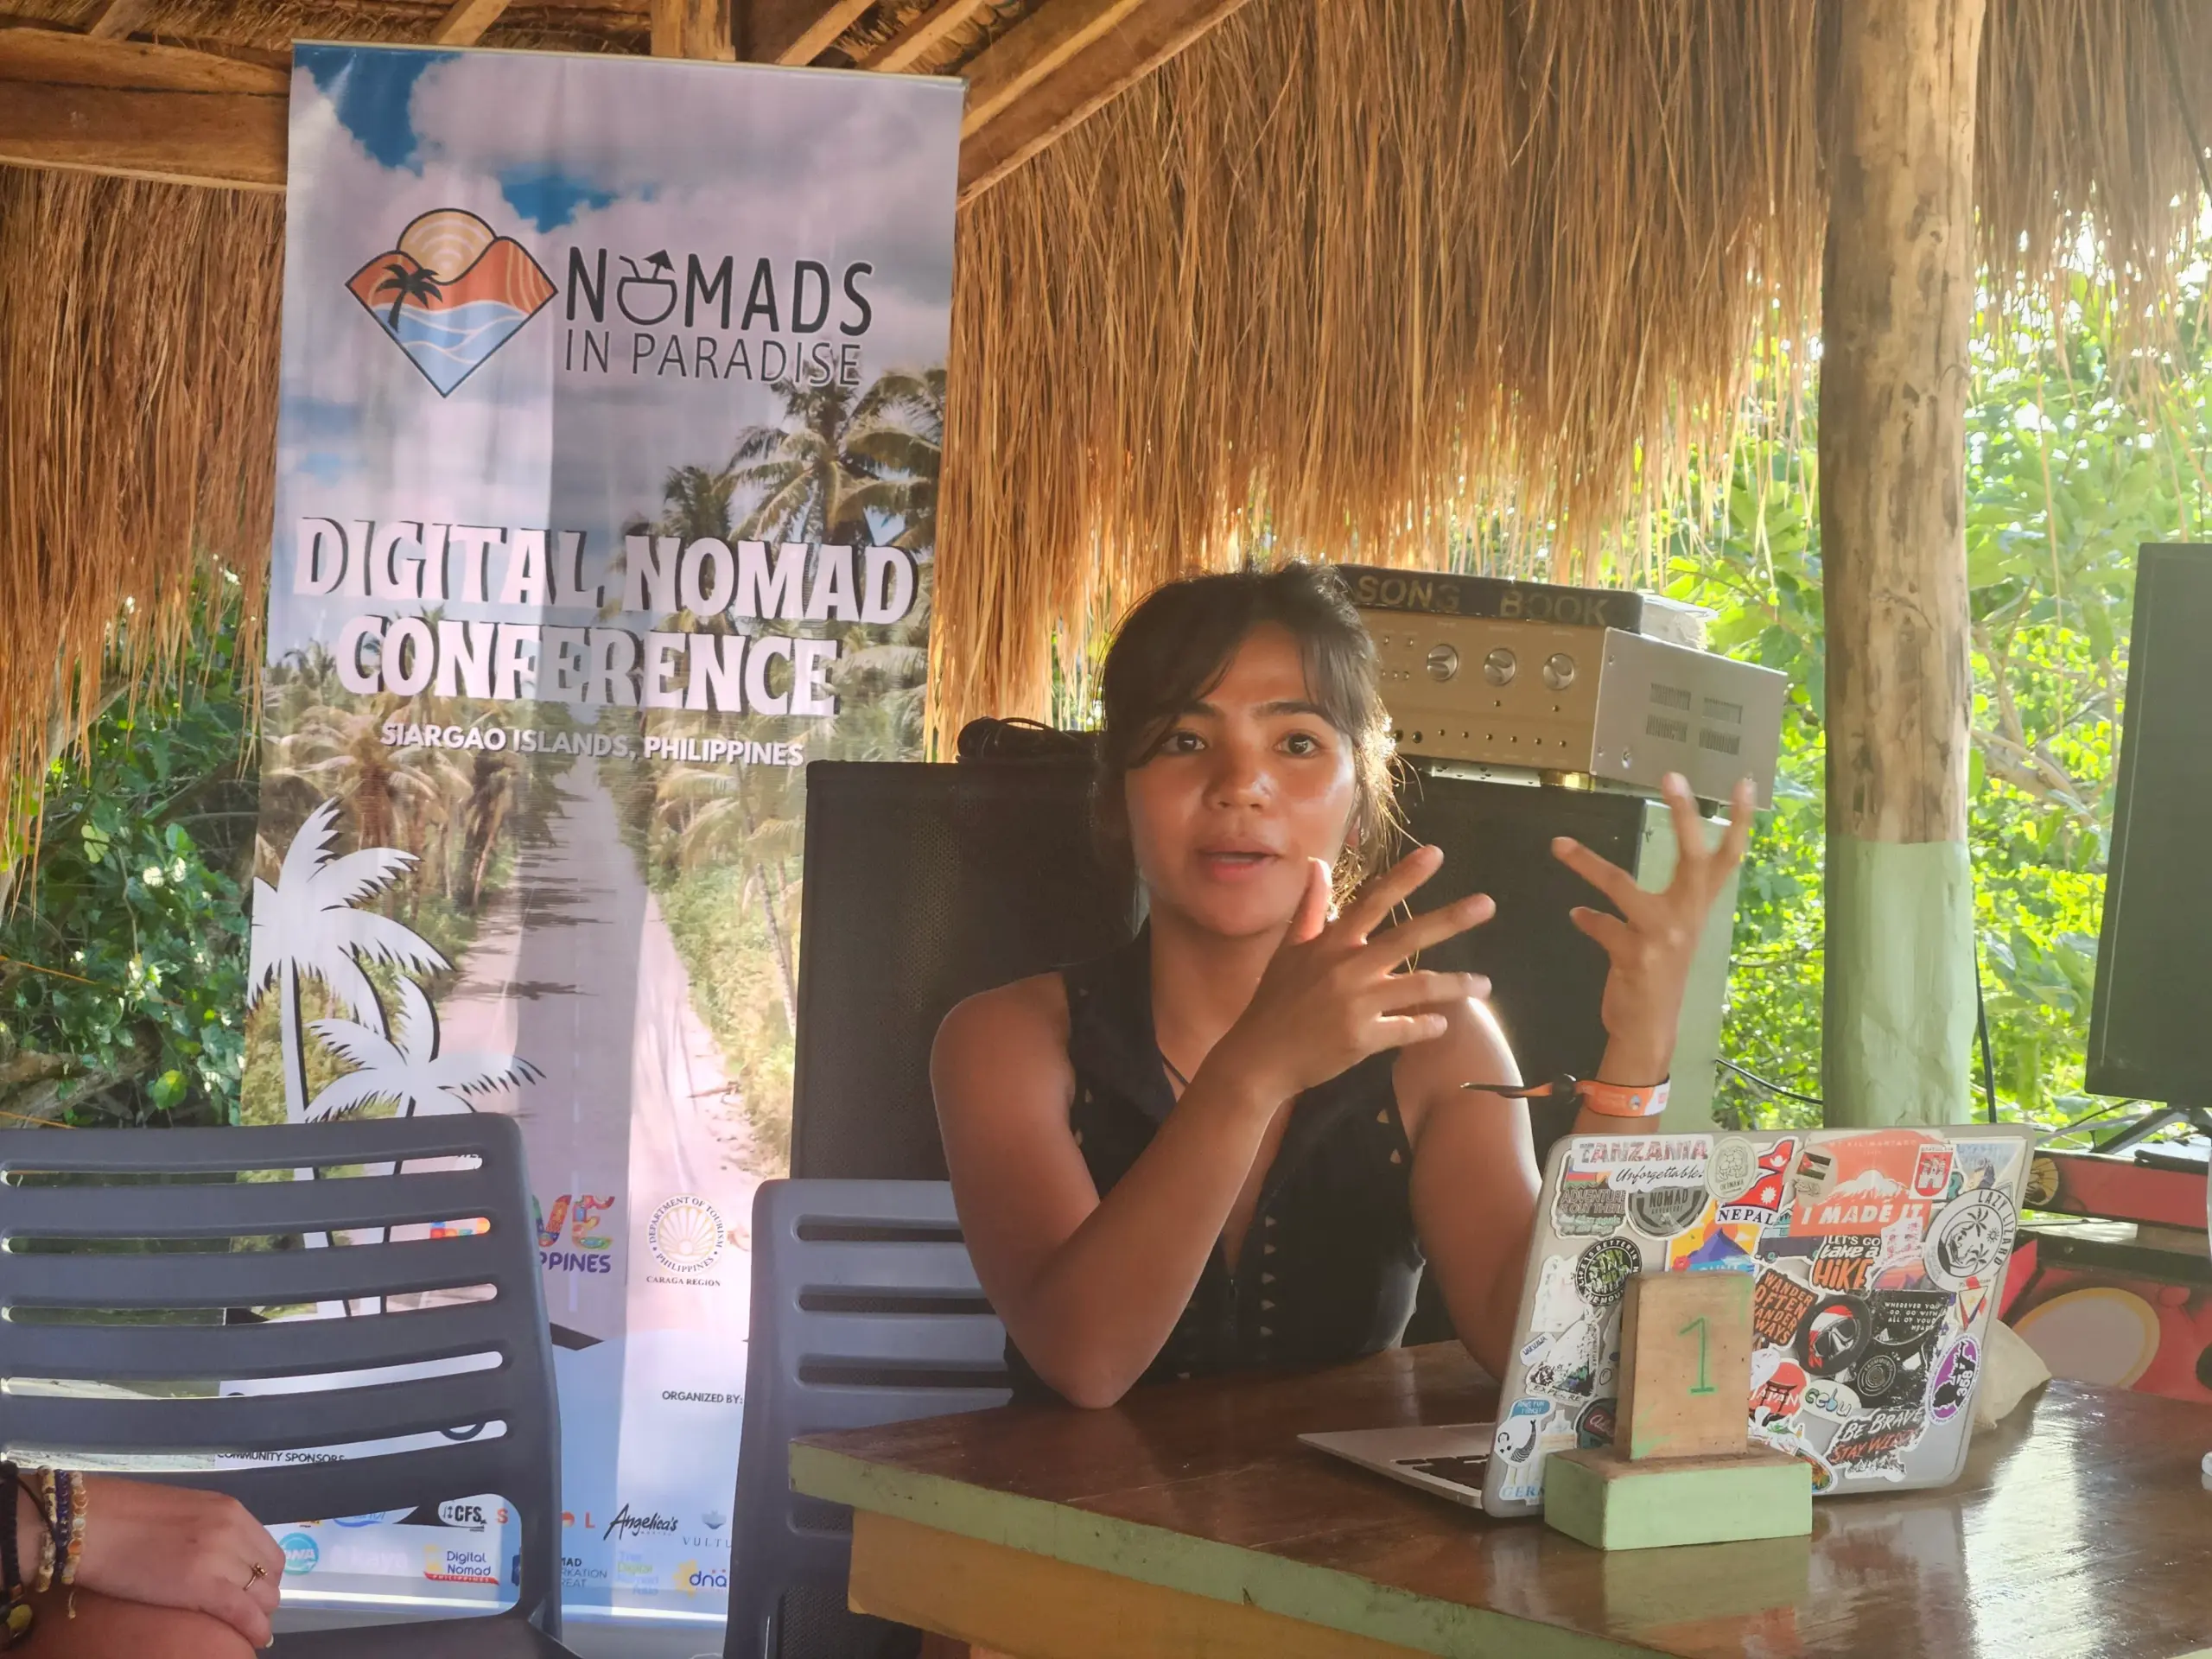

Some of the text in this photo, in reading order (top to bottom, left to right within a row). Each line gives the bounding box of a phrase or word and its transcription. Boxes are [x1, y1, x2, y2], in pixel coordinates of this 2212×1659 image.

[565, 245, 874, 337] NOMADS
[565, 328, 861, 387] IN PARADISE
[293, 516, 918, 625] DIGITAL NOMAD
[1357, 574, 1609, 627] SONG BOOK
[335, 613, 843, 718] CONFERENCE
[380, 721, 804, 767] SIARGAO ISLANDS, PHILIPPINES
[1579, 1140, 1709, 1164] TANZANIA
[1560, 1189, 1626, 1204] ADVENTURE
[1649, 1188, 1689, 1208] NOMAD
[1568, 1203, 1592, 1214] OUT
[1592, 1203, 1626, 1215] THERE
[1717, 1208, 1774, 1226] NEPAL
[1801, 1206, 1813, 1225] I
[1818, 1200, 1894, 1225] MADE
[532, 1194, 615, 1250] VE
[648, 1197, 725, 1249] DEPARTMENT OF TOURISM
[1977, 1190, 2009, 1211] LAZY
[1993, 1212, 2016, 1266] LIZARD
[1595, 1239, 1631, 1252] BETTER
[1820, 1244, 1880, 1259] take a
[1827, 1235, 1881, 1247] LET'S GO
[656, 1253, 715, 1274] PHILIPPINES
[645, 1275, 684, 1285] CARAGA
[1764, 1272, 1814, 1307] WANDER
[1599, 1289, 1624, 1305] MOU
[1754, 1284, 1808, 1321] OFTEN
[1754, 1306, 1797, 1332] ANDER
[1755, 1319, 1791, 1344] WAYS
[1678, 1317, 1719, 1395] 1
[1956, 1370, 1974, 1397] 358
[661, 1389, 744, 1405] ORGANIZED BY:
[1750, 1385, 1799, 1408] JAPAN
[1804, 1387, 1853, 1418] cebu
[1839, 1408, 1924, 1442] BE BRAVE
[1828, 1441, 1868, 1464] STAY
[1503, 1486, 1543, 1497] GER
[454, 1504, 483, 1523] CFS
[603, 1503, 679, 1541] Angelica's
[683, 1535, 732, 1548] VULTU
[446, 1550, 487, 1565] Digital
[447, 1564, 492, 1576] Nomad
